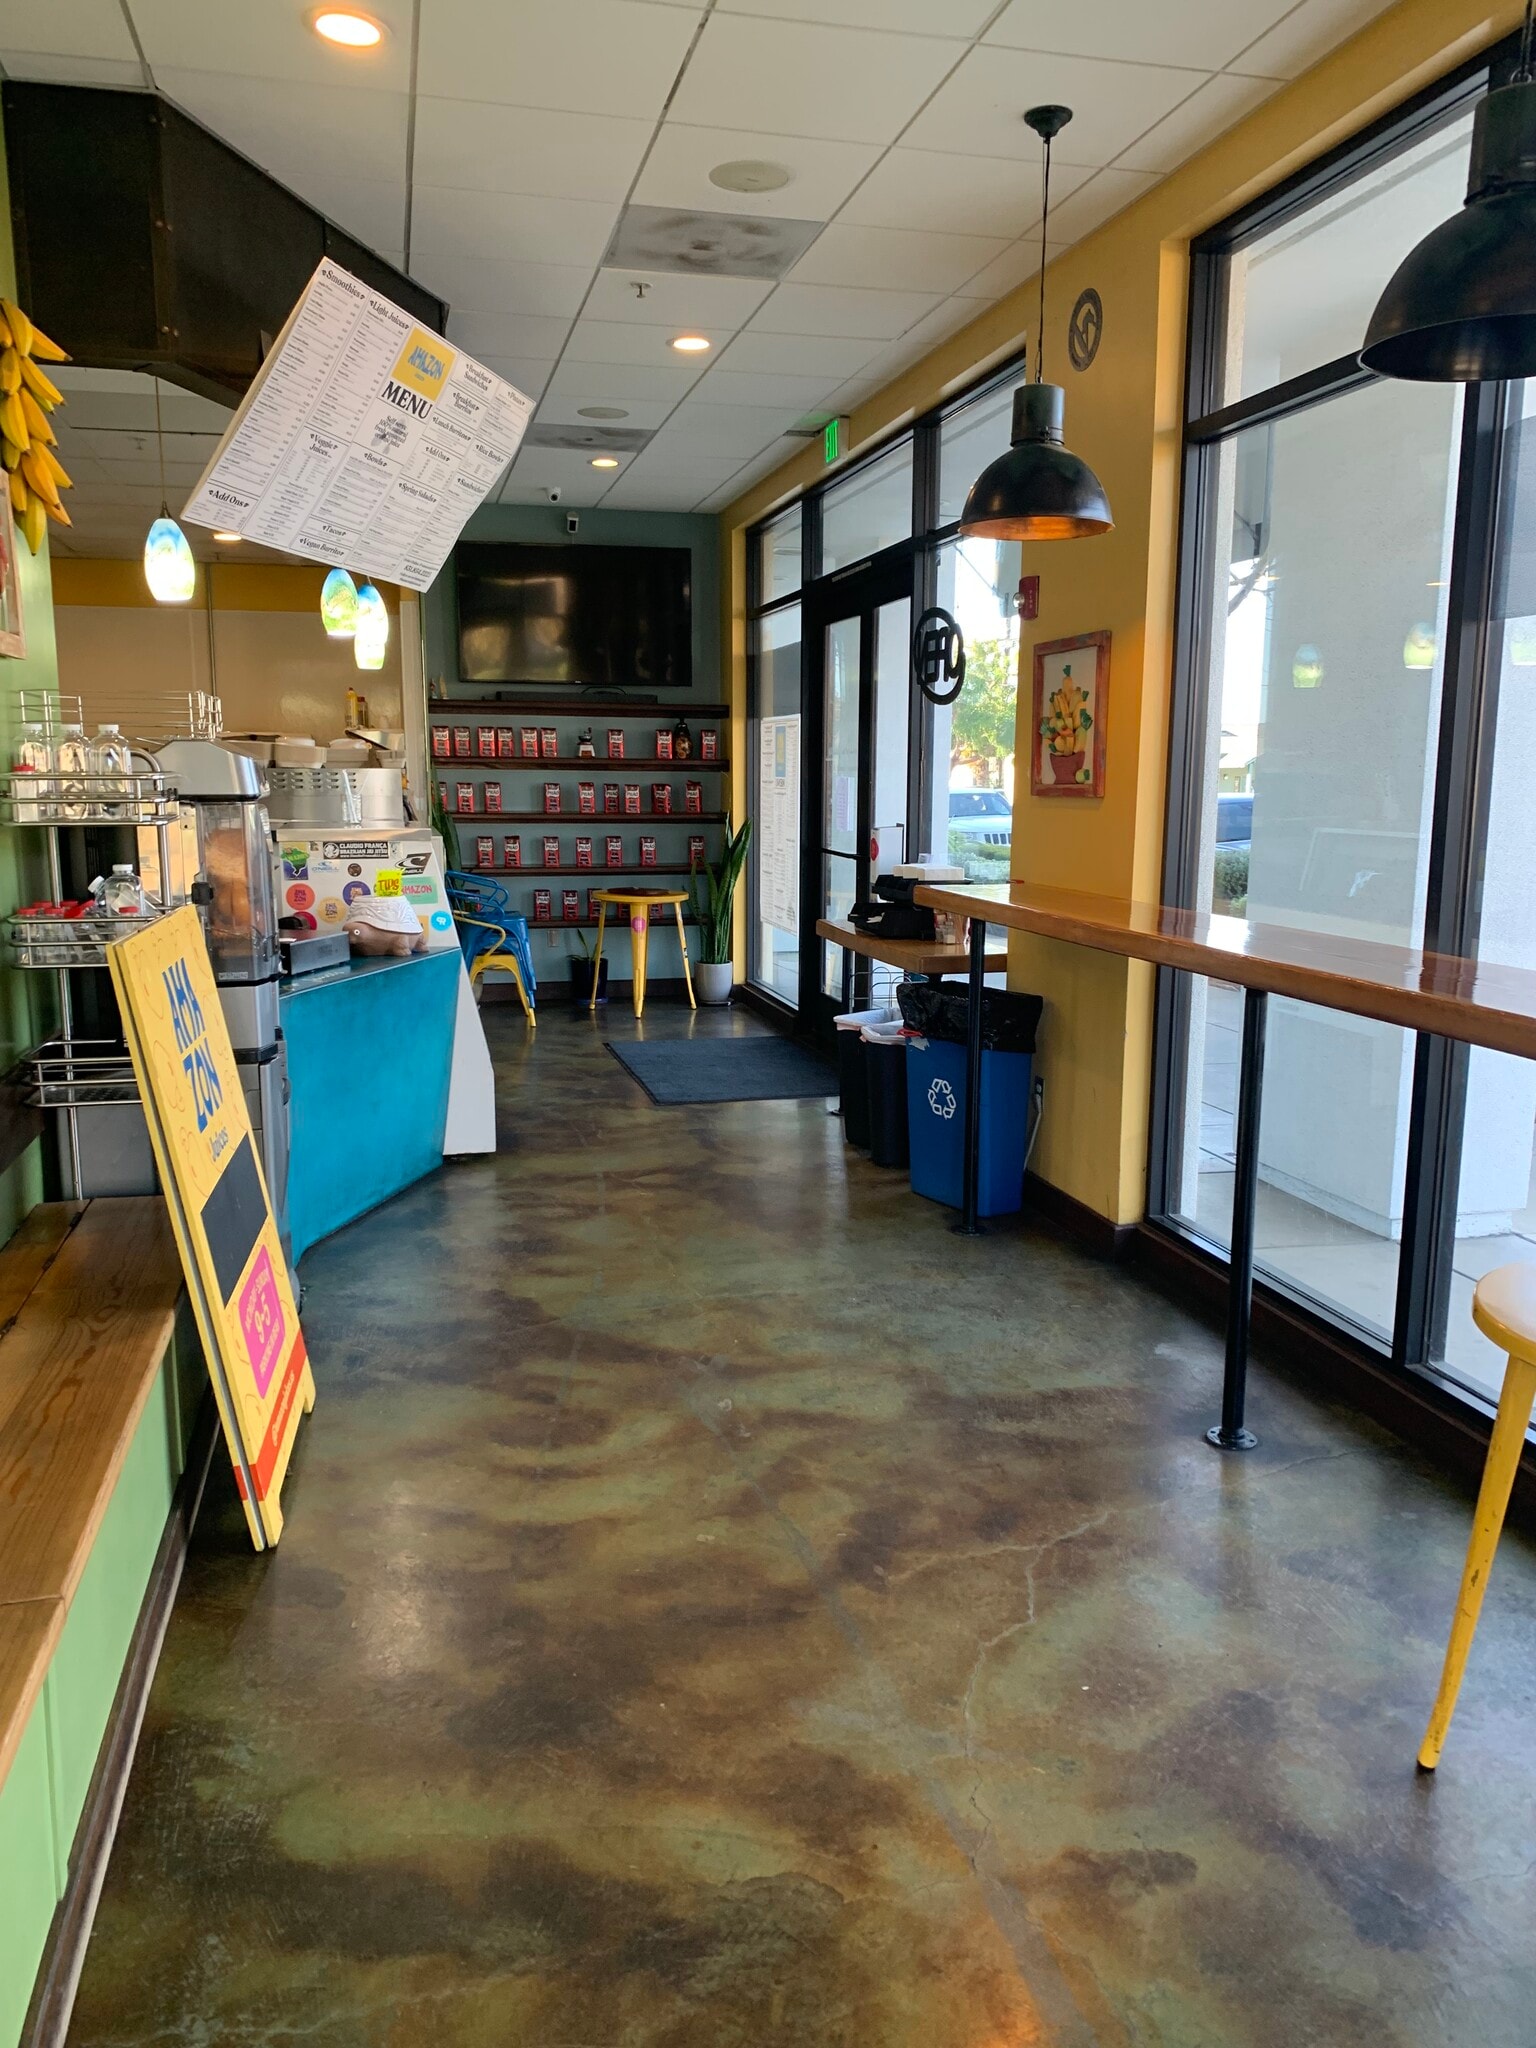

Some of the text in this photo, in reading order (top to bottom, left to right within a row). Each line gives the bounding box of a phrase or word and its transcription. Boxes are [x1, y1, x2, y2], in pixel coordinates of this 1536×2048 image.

[326, 270, 360, 298] Smoothies
[372, 301, 405, 328] Light Juices
[408, 345, 445, 380] AMAZON
[381, 380, 433, 419] MENU
[435, 417, 449, 430] Lunch
[314, 435, 334, 449] Veggie
[309, 443, 328, 457] Juices
[430, 447, 447, 461] Add Ons
[367, 453, 384, 467] Bowls
[402, 483, 418, 496] Spring
[212, 490, 244, 507] Add Ons
[326, 525, 343, 537] Tacos
[303, 538, 320, 550] Vegan
[378, 879, 400, 891] TIPS
[182, 1037, 223, 1134] ZON
